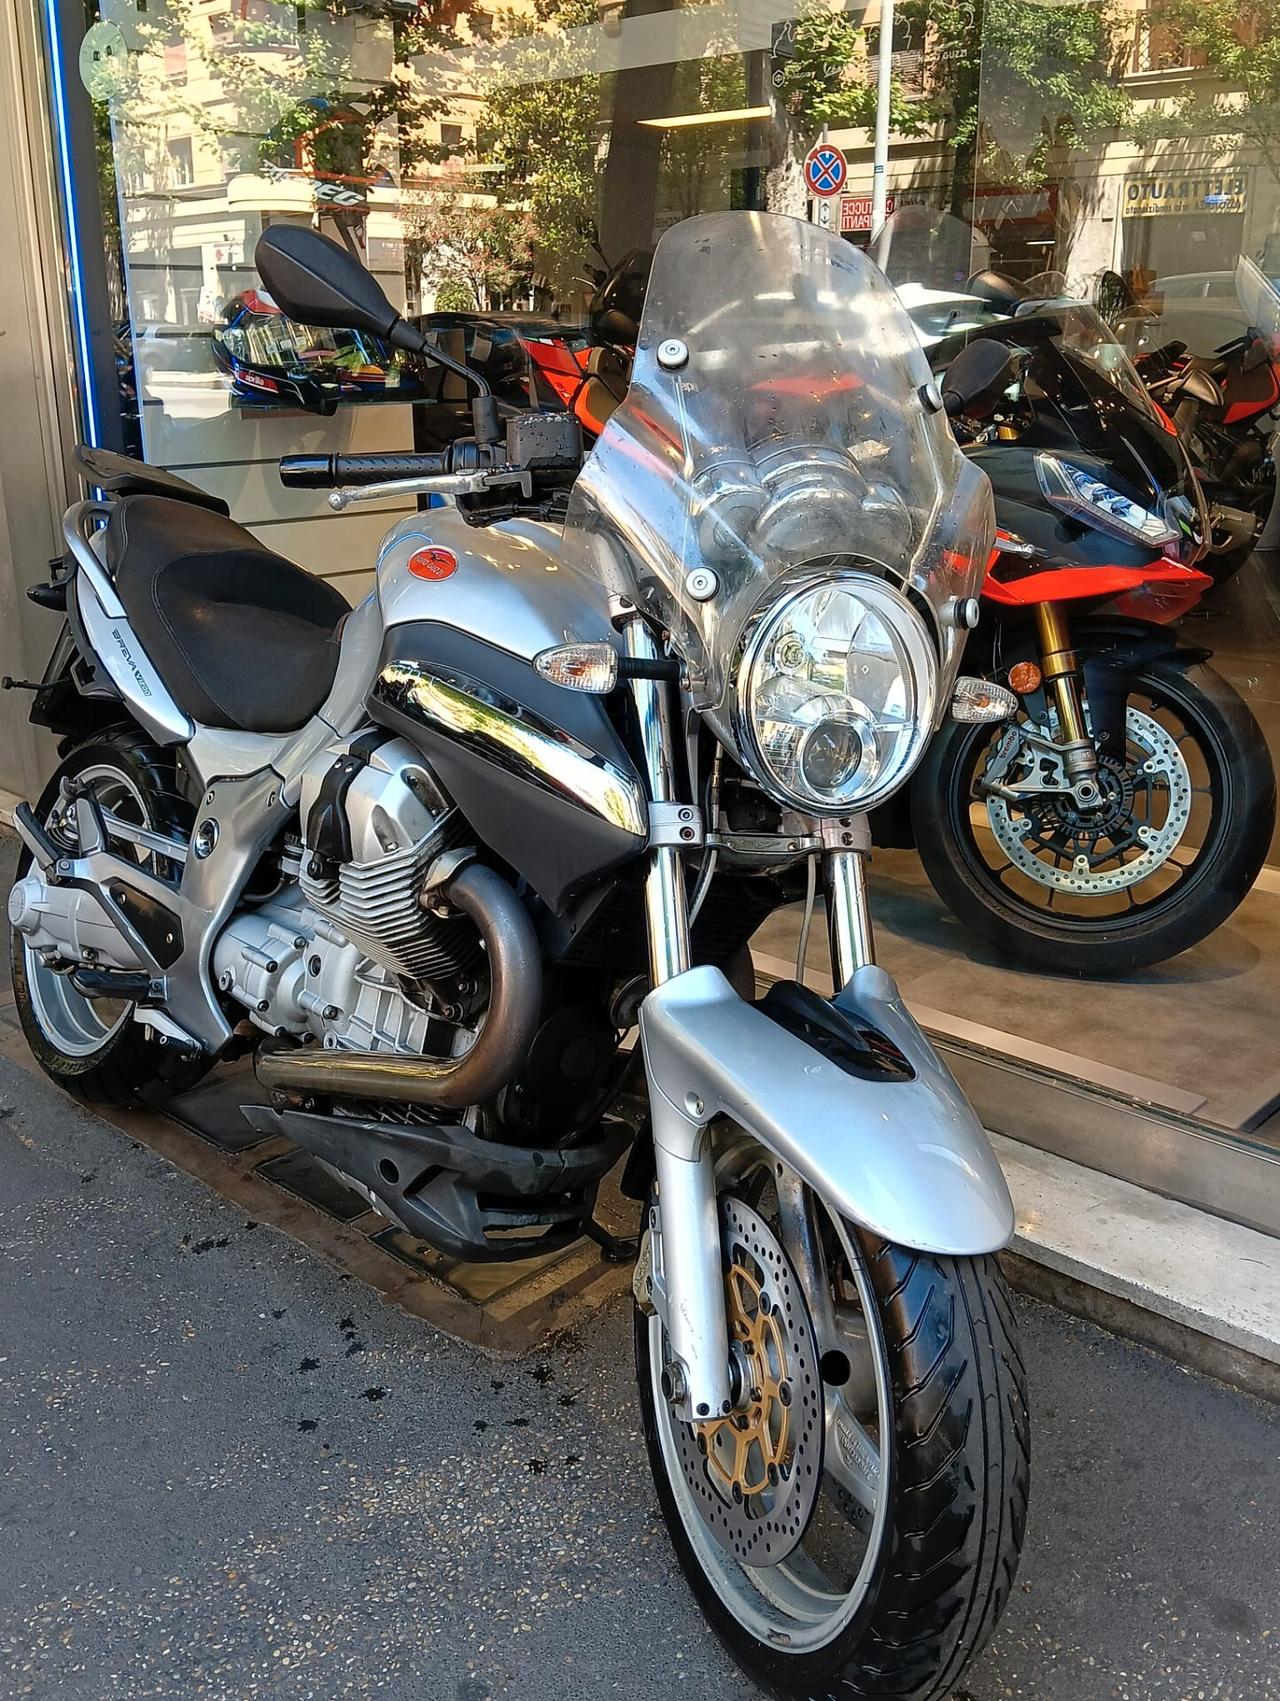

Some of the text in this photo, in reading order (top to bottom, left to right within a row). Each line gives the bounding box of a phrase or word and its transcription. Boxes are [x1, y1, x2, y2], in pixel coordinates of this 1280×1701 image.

[942, 49, 968, 60] GUZZI
[111, 627, 137, 672] BREVA
[999, 731, 1018, 759] brembo
